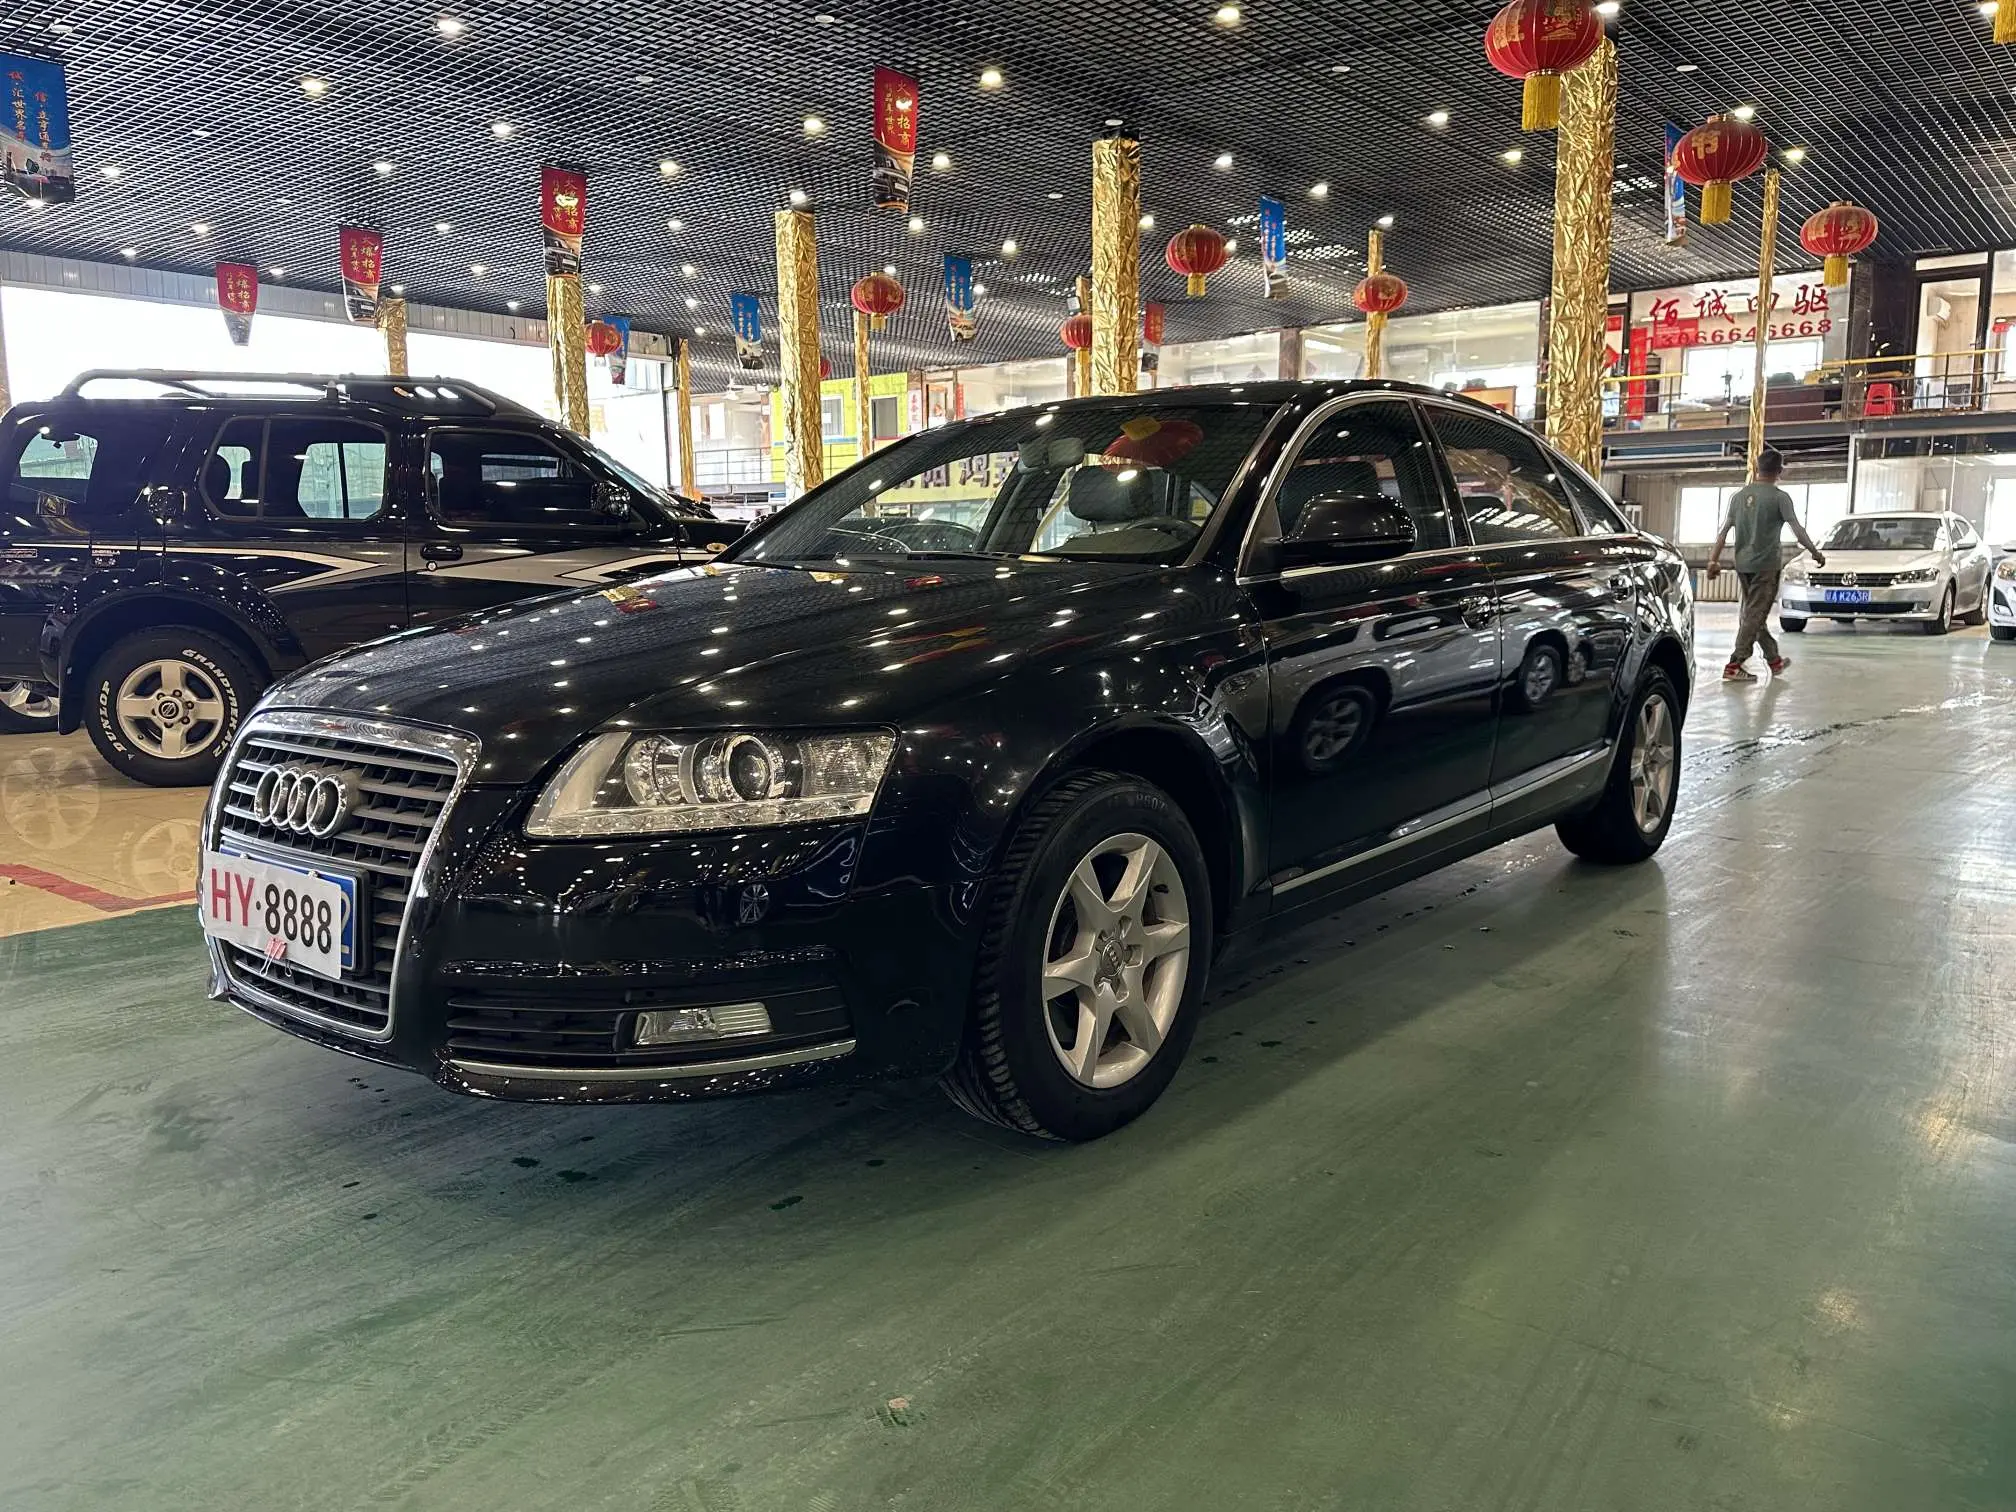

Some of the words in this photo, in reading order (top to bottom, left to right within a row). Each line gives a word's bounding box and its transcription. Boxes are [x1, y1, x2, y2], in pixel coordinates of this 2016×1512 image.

[896, 80, 912, 149] 火招商
[99, 680, 127, 752] DUNLOP
[182, 648, 239, 730] GRANDTREK
